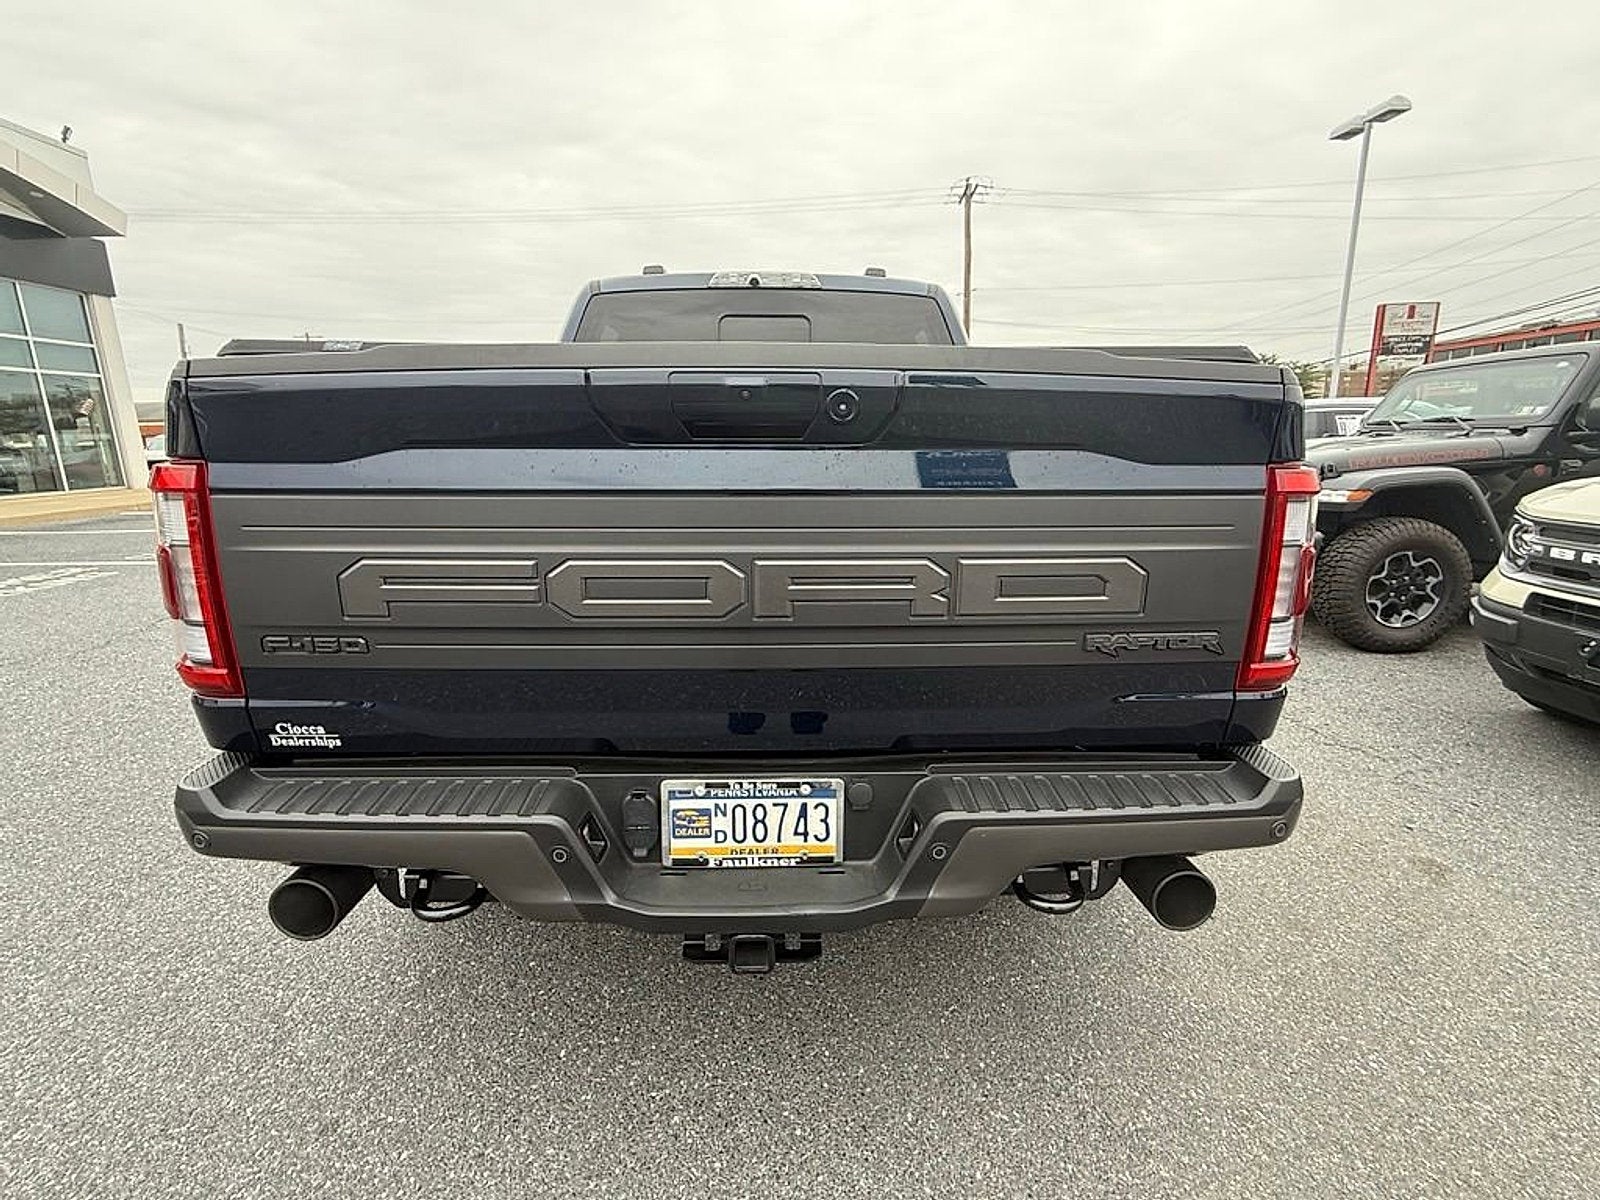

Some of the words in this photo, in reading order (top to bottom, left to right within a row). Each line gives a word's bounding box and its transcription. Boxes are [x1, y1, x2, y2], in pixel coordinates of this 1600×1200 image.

[337, 557, 1148, 621] FORD
[1083, 630, 1224, 660] RAPTOR
[275, 722, 326, 735] Ciocca
[271, 735, 342, 749] Dealerships
[731, 802, 831, 844] 08743
[674, 827, 711, 837] DEALER
[708, 856, 801, 868] Faulkner
